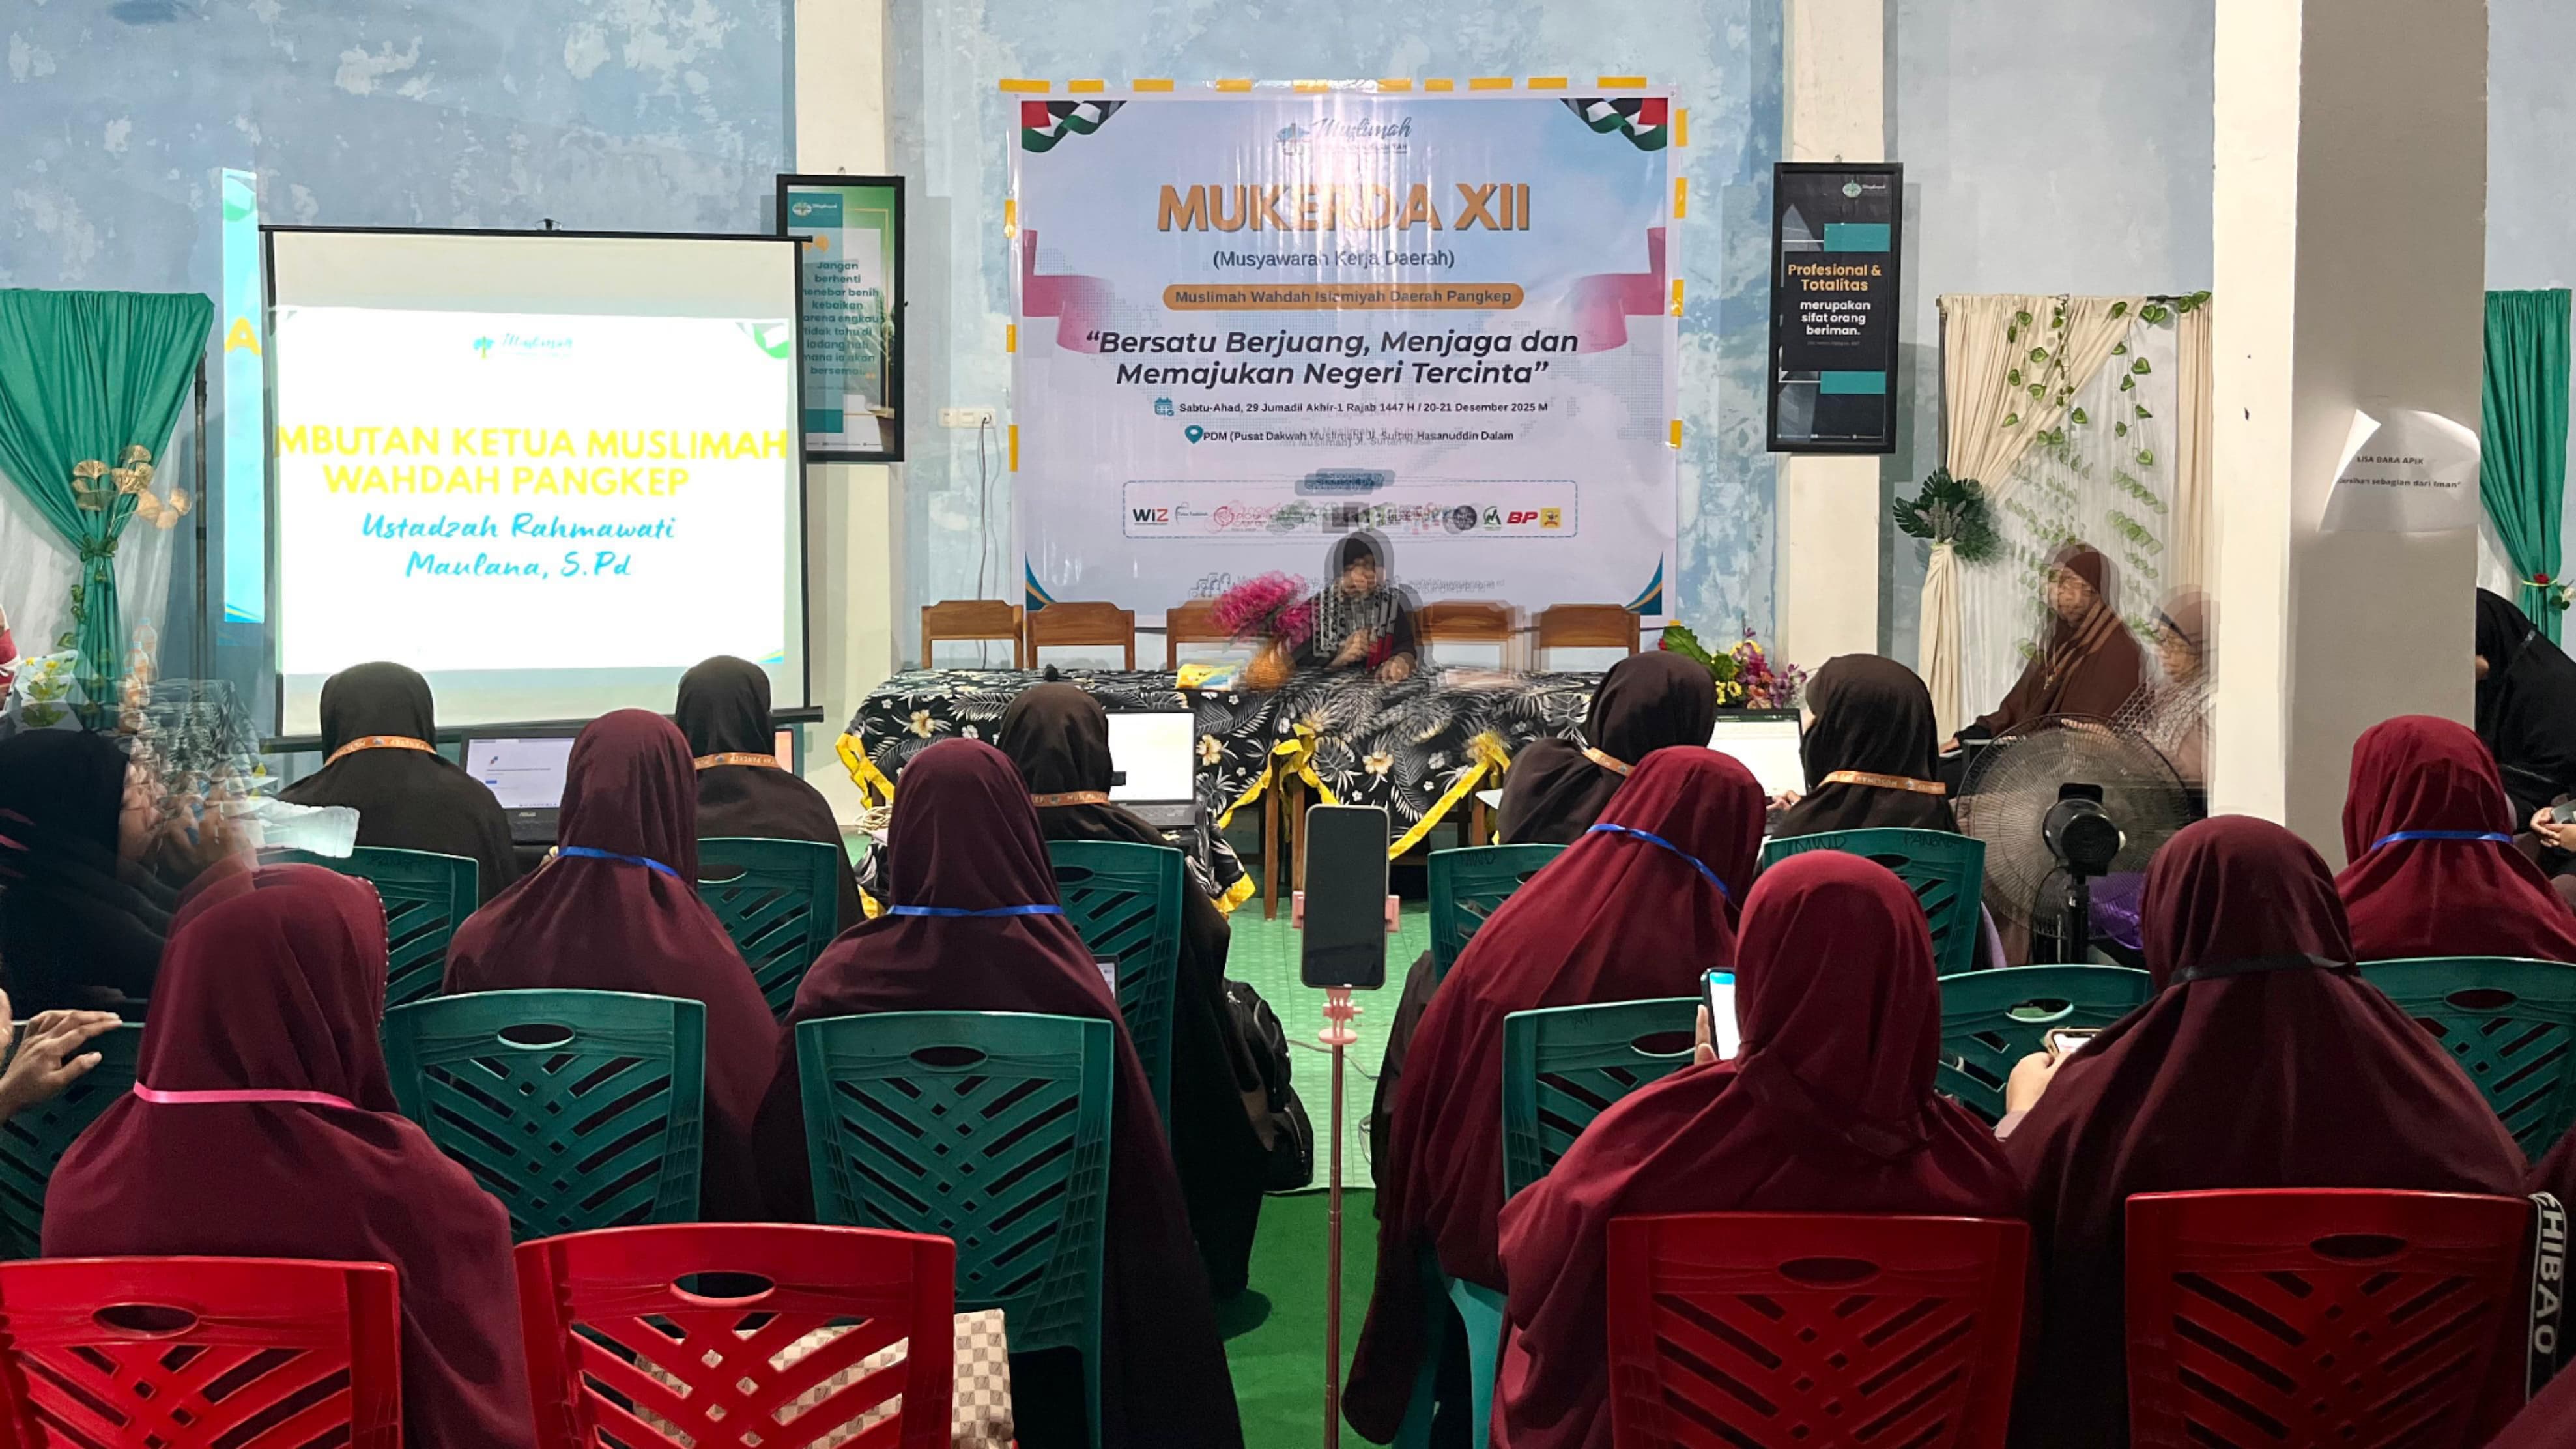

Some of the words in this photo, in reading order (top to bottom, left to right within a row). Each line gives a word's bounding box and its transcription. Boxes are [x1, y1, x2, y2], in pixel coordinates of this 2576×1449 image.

[1157, 184, 1444, 233] MUKERDA
[1454, 184, 1530, 231] XII
[1213, 250, 1330, 270] (Musyawarah
[1334, 250, 1380, 269] Kerja
[1385, 249, 1455, 268] Daerah)
[816, 261, 859, 273] Jangan
[1788, 263, 1868, 276] Profesional
[1870, 265, 1882, 276] &
[814, 274, 861, 283] berhenti
[1800, 278, 1869, 291] Totalitas
[848, 287, 879, 296] benih
[1175, 291, 1246, 303] Muslimah
[1250, 291, 1311, 303] Wahdah
[1315, 291, 1385, 305] Islamiyah
[1390, 291, 1442, 302] Daerah
[1447, 291, 1511, 305] Pangkep
[812, 300, 864, 310] kebaikan
[1800, 300, 1871, 313] merupakan
[1801, 313, 1828, 323] sifat
[1829, 315, 1866, 326] orang
[805, 327, 831, 336] tidak
[1805, 324, 1861, 336] beriman.
[807, 338, 845, 352] ladang
[1087, 331, 1217, 353] “Bersatu
[1225, 329, 1370, 358] Berjuang,
[1381, 329, 1512, 358] Menjaga
[1521, 330, 1578, 352] dan
[1116, 360, 1295, 390] Memajukan
[1302, 360, 1403, 389] Negeri
[1412, 360, 1549, 384] Tercinta”
[1179, 403, 1244, 413] Sabtu-Ahad,
[1246, 404, 1259, 412] 29
[1261, 403, 1302, 412] Jumadil
[1306, 403, 1343, 412] Akhir-1
[1346, 403, 1376, 414] Rajab
[1379, 403, 1404, 412] 1447
[1407, 403, 1414, 412] H
[1423, 403, 1452, 412] 20-21
[1455, 403, 1508, 412] Desember
[1511, 403, 1536, 412] 2025
[1538, 403, 1548, 412] M
[1203, 431, 1227, 441] PDM
[1229, 431, 1264, 443] (Pusat
[1266, 431, 1308, 441] Dakwah
[1417, 430, 1478, 440] Hasanuddin
[1481, 431, 1513, 440] Dalam
[452, 427, 576, 459] KETUA
[587, 429, 787, 460] MUSLIMAH
[322, 465, 500, 495] WAHDAH
[512, 466, 690, 496] PANGKEP
[2372, 478, 2410, 487] sebagian
[1507, 511, 1538, 523] BP
[362, 512, 499, 539] Ustadzah
[511, 512, 676, 539] Rahmawati
[405, 550, 548, 579] Maulana,
[560, 550, 631, 577] S.Pd
